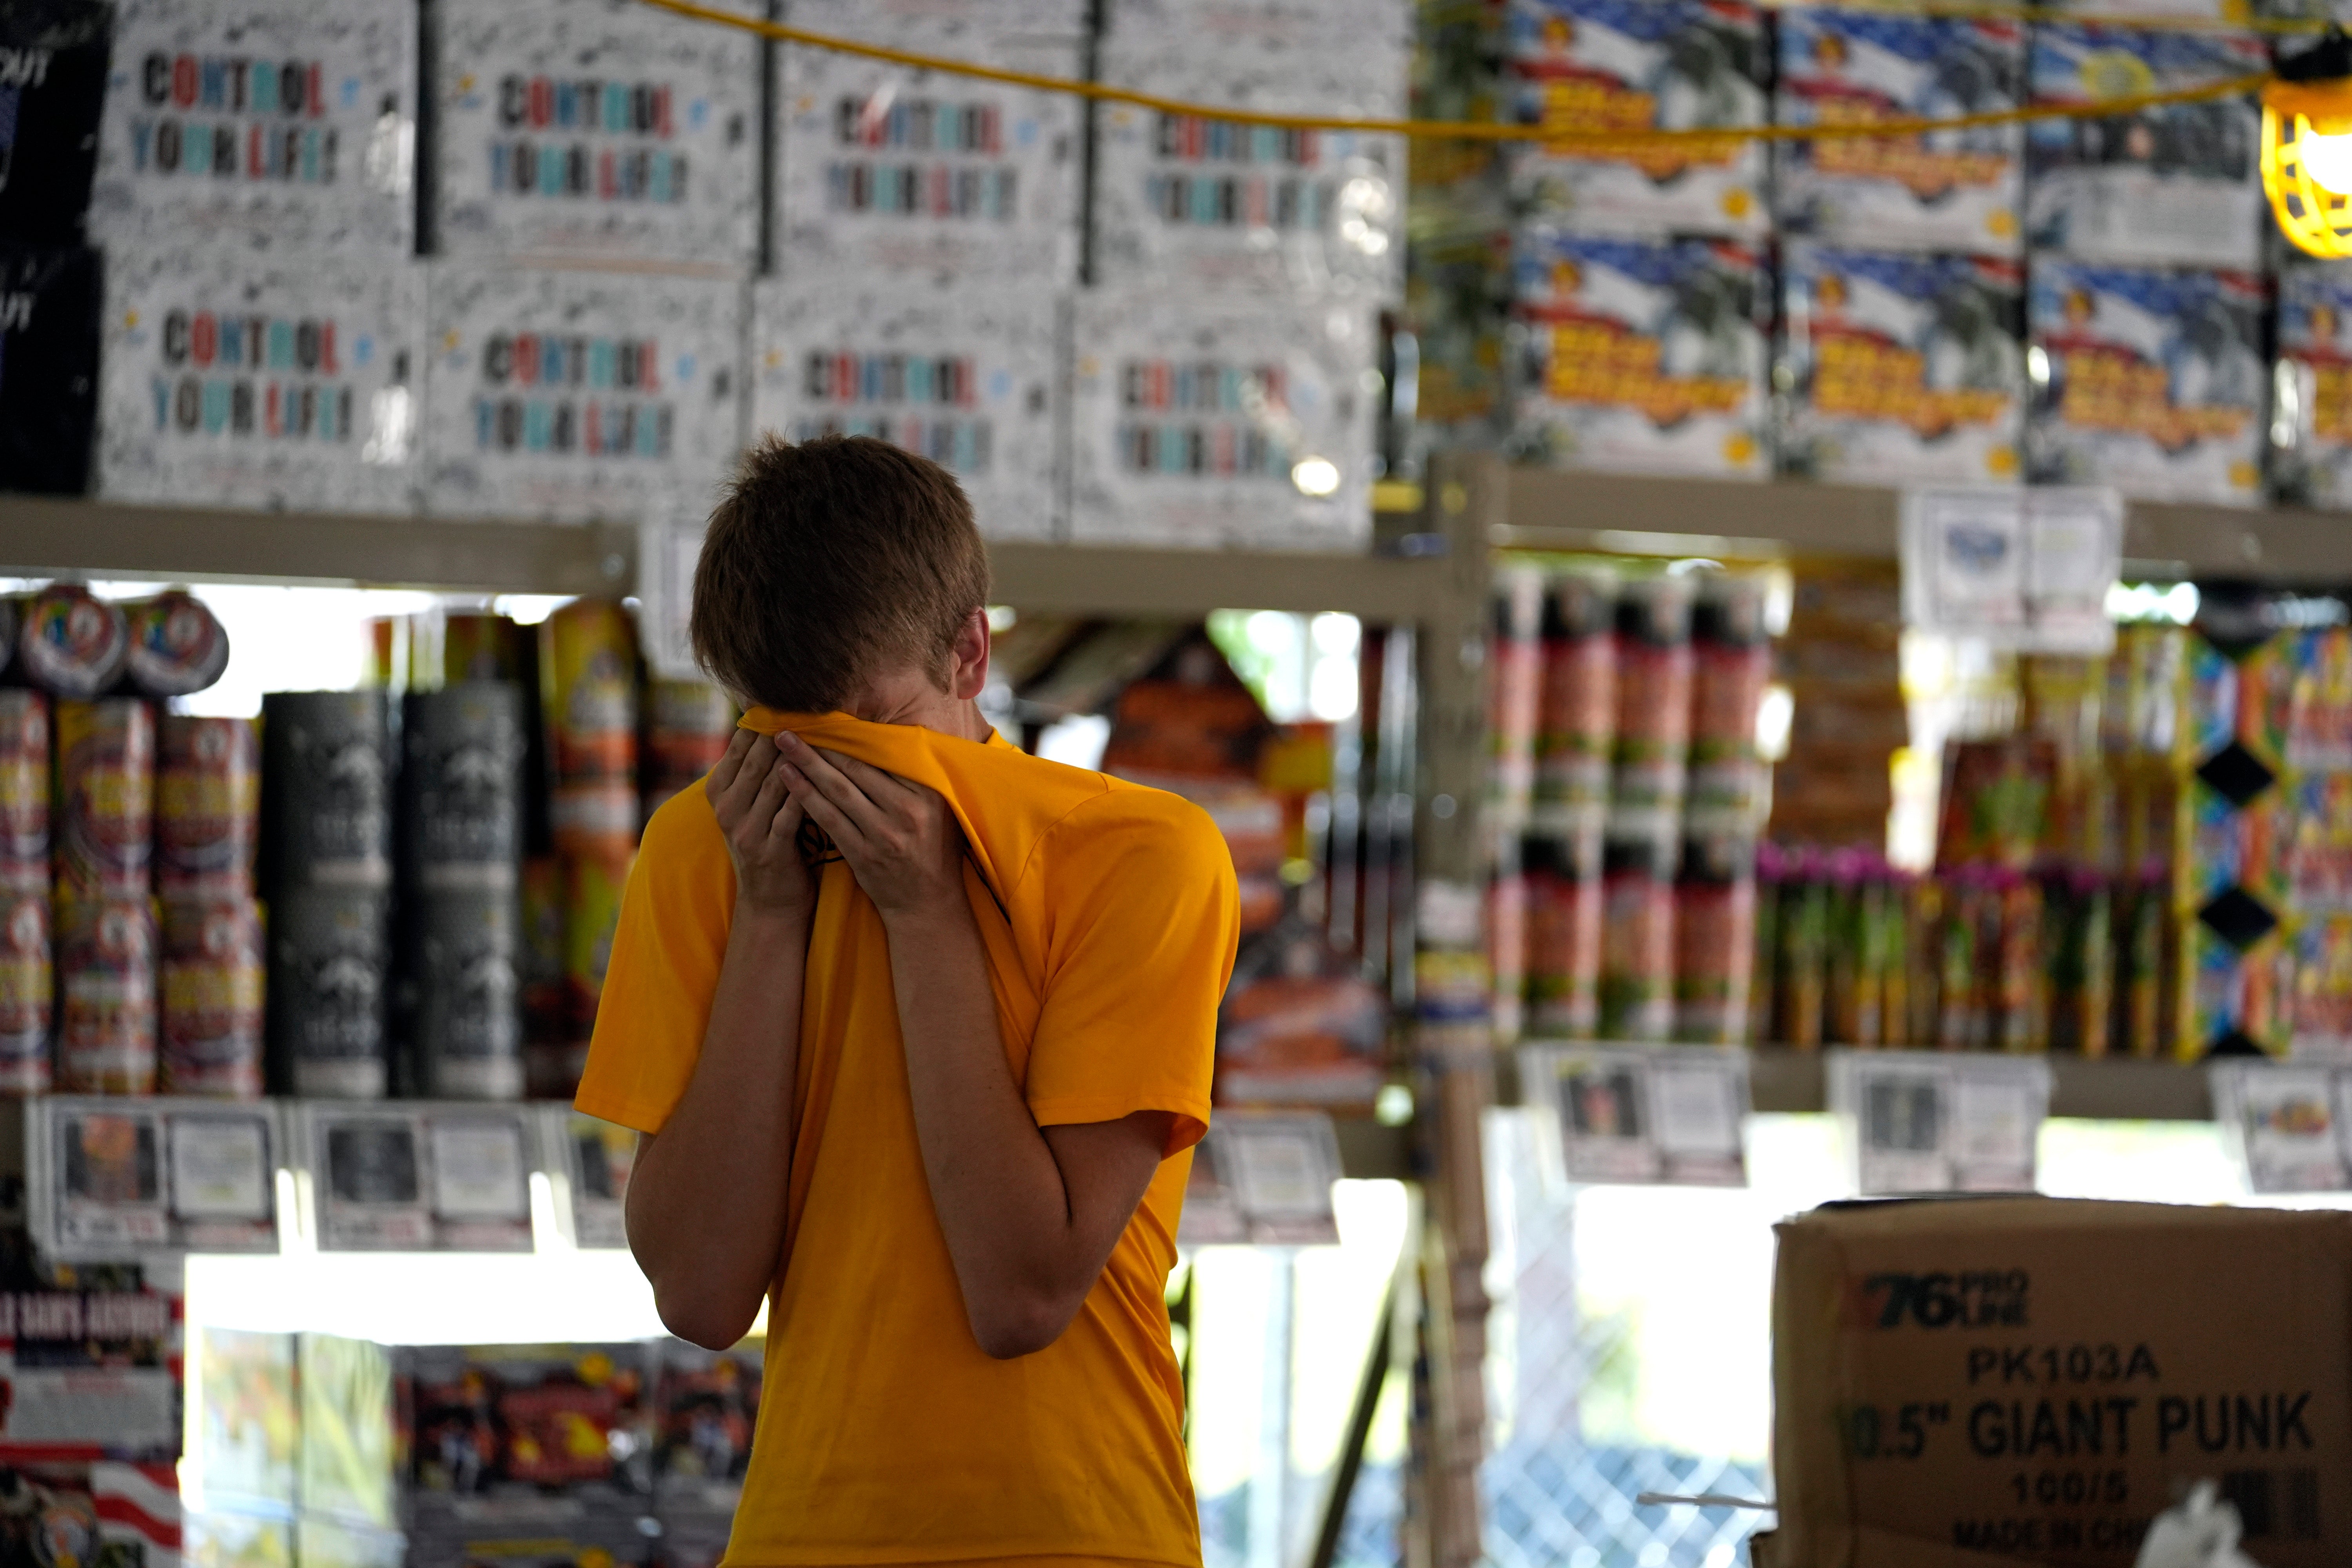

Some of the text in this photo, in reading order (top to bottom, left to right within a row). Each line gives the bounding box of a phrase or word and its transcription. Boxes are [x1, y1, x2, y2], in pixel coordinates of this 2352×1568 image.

[142, 49, 326, 119] CONTROL
[129, 118, 235, 179] YOUR
[162, 306, 341, 378] CONTROL
[151, 372, 254, 437] YOUR
[1966, 1342, 2160, 1385] PK103A
[1968, 1396, 2139, 1459] GIANT
[2158, 1390, 2314, 1453] PUNK
[1954, 1519, 2041, 1554] MADE
[2051, 1518, 2082, 1552] IN
